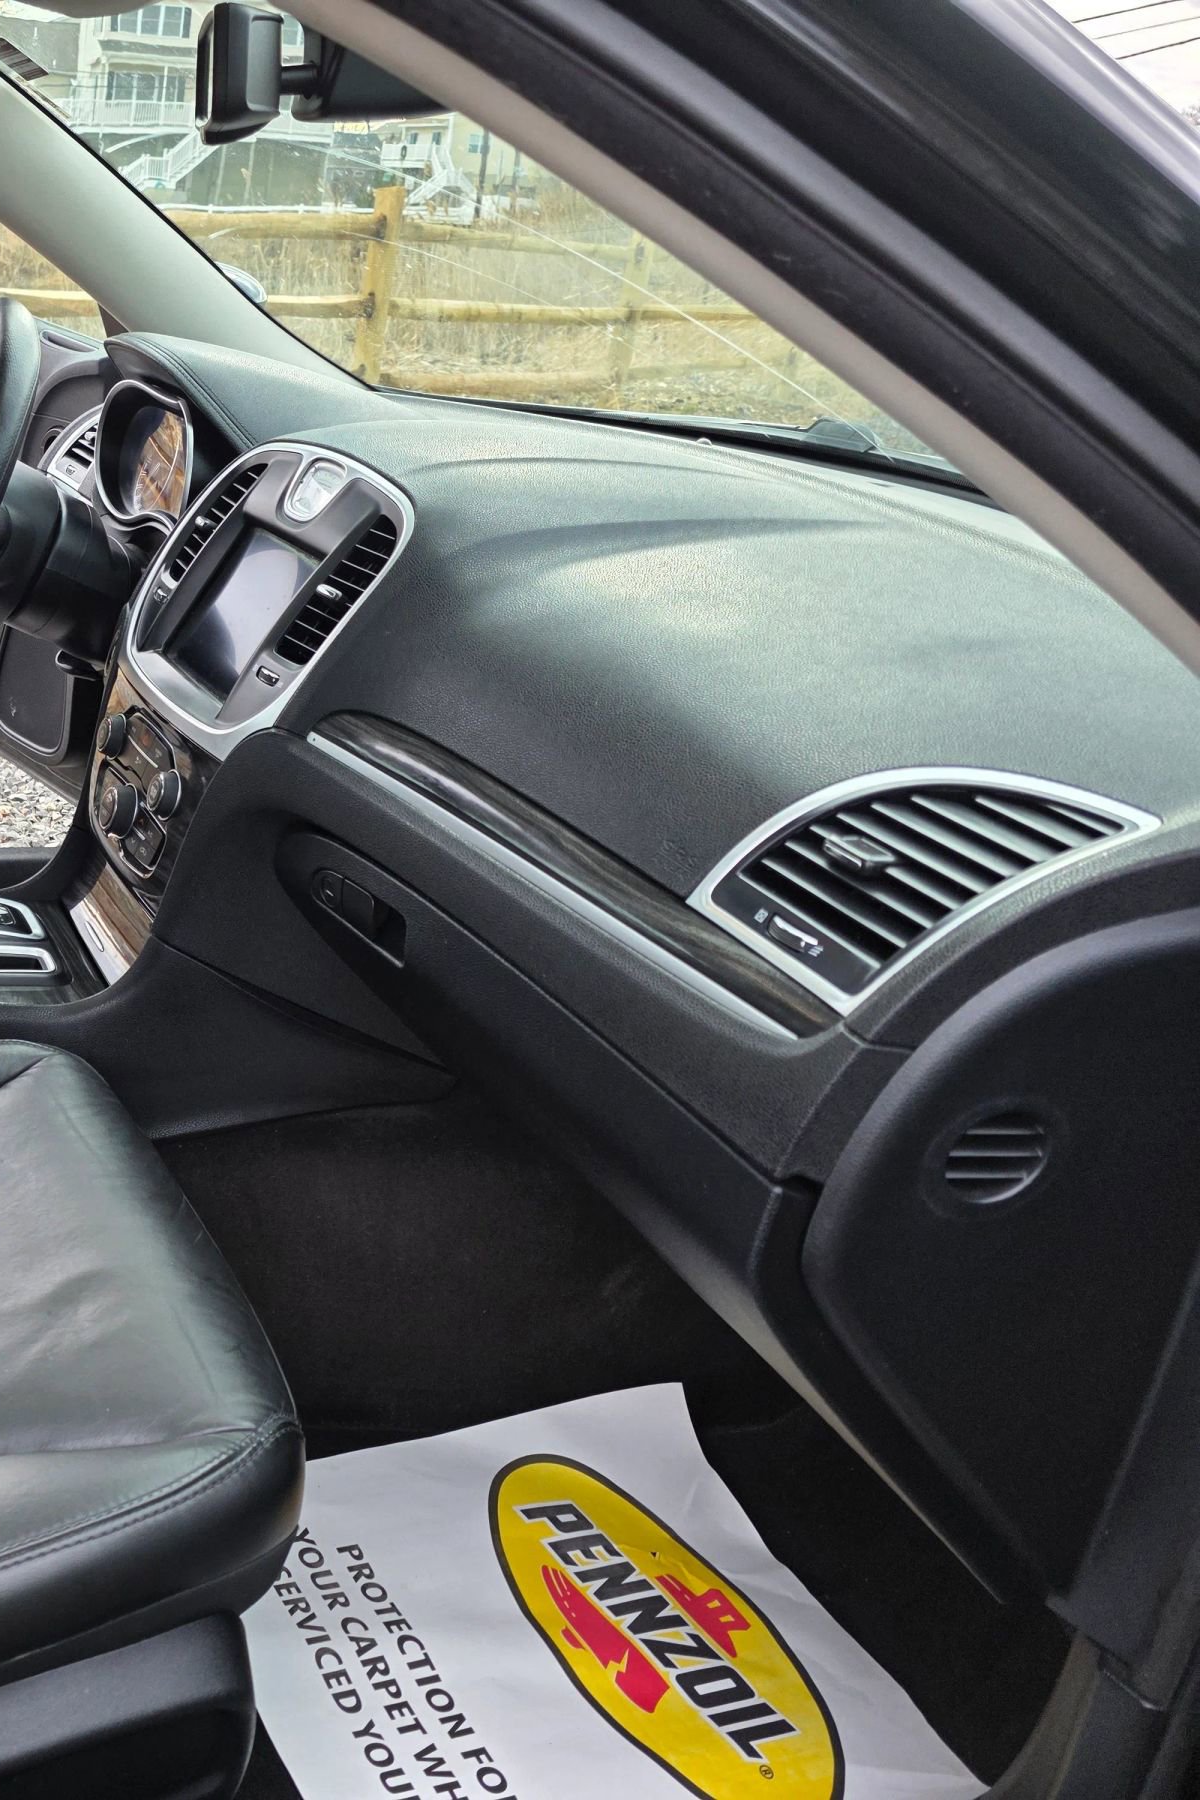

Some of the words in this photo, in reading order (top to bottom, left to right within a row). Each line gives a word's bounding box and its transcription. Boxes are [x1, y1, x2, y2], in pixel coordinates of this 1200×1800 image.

[292, 1527, 350, 1611] YOUR
[340, 1616, 428, 1735] CARPET
[336, 1543, 475, 1739] PROTECTION
[460, 1746, 519, 1800] FO
[514, 1500, 800, 1763] PENNZOIL
[352, 1718, 421, 1800] YOU
